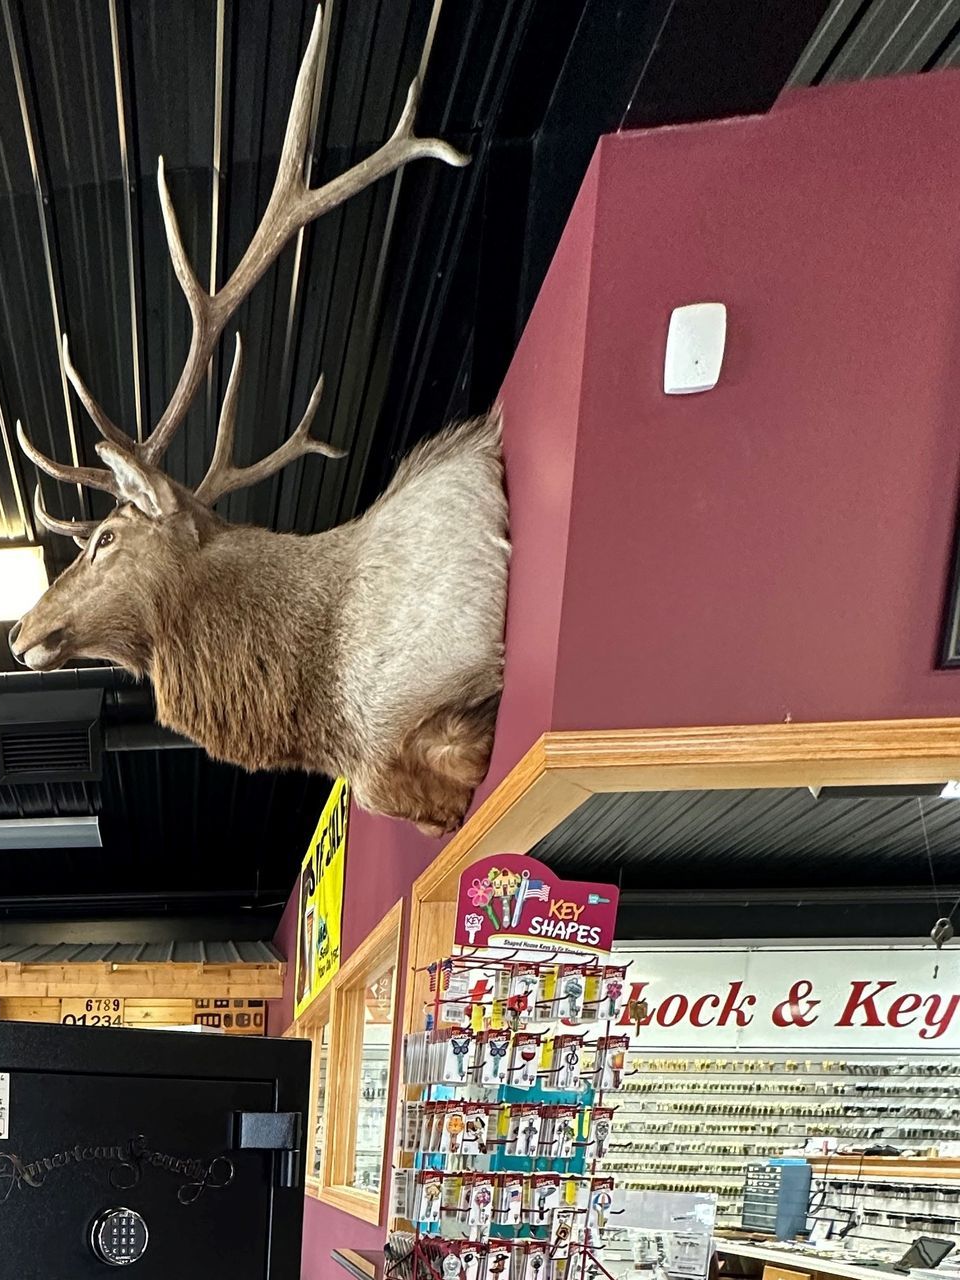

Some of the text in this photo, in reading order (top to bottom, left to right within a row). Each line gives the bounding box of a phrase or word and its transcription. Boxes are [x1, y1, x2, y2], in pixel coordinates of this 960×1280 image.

[548, 899, 584, 921] KEY
[528, 917, 601, 945] SHAPES
[615, 980, 960, 1039] Lock & Key
